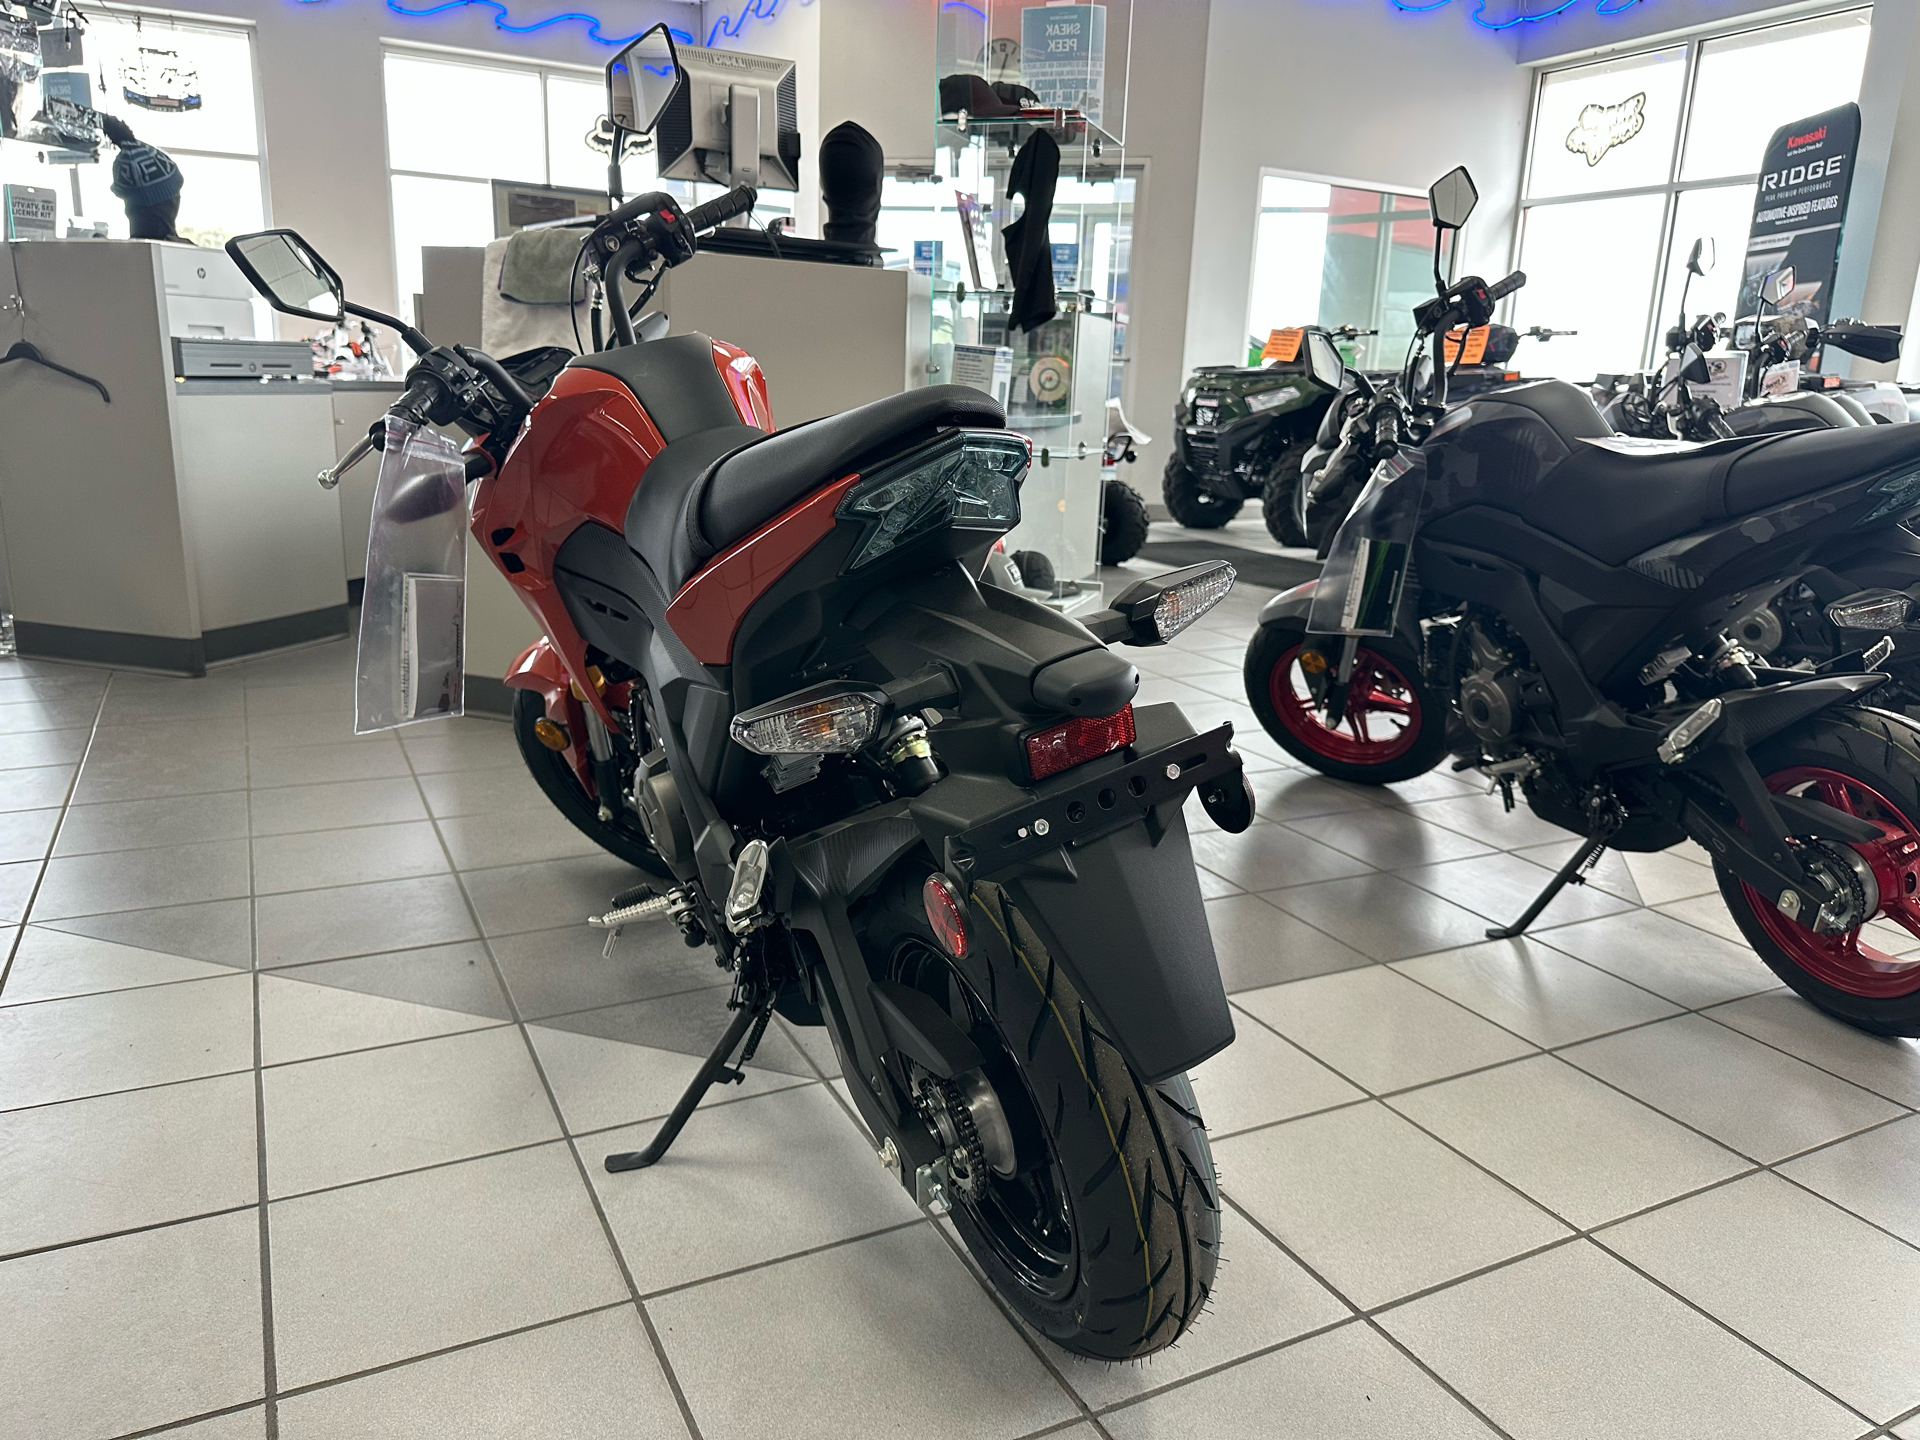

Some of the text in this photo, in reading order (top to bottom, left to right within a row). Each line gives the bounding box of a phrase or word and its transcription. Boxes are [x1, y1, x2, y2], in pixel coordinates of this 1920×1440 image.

[1761, 154, 1842, 192] RIDGE
[1776, 189, 1797, 199] PREMIUM
[1798, 180, 1832, 195] PERFORMANCE
[1811, 195, 1839, 212] FEATURES
[12, 208, 51, 219] LICENSE KIT
